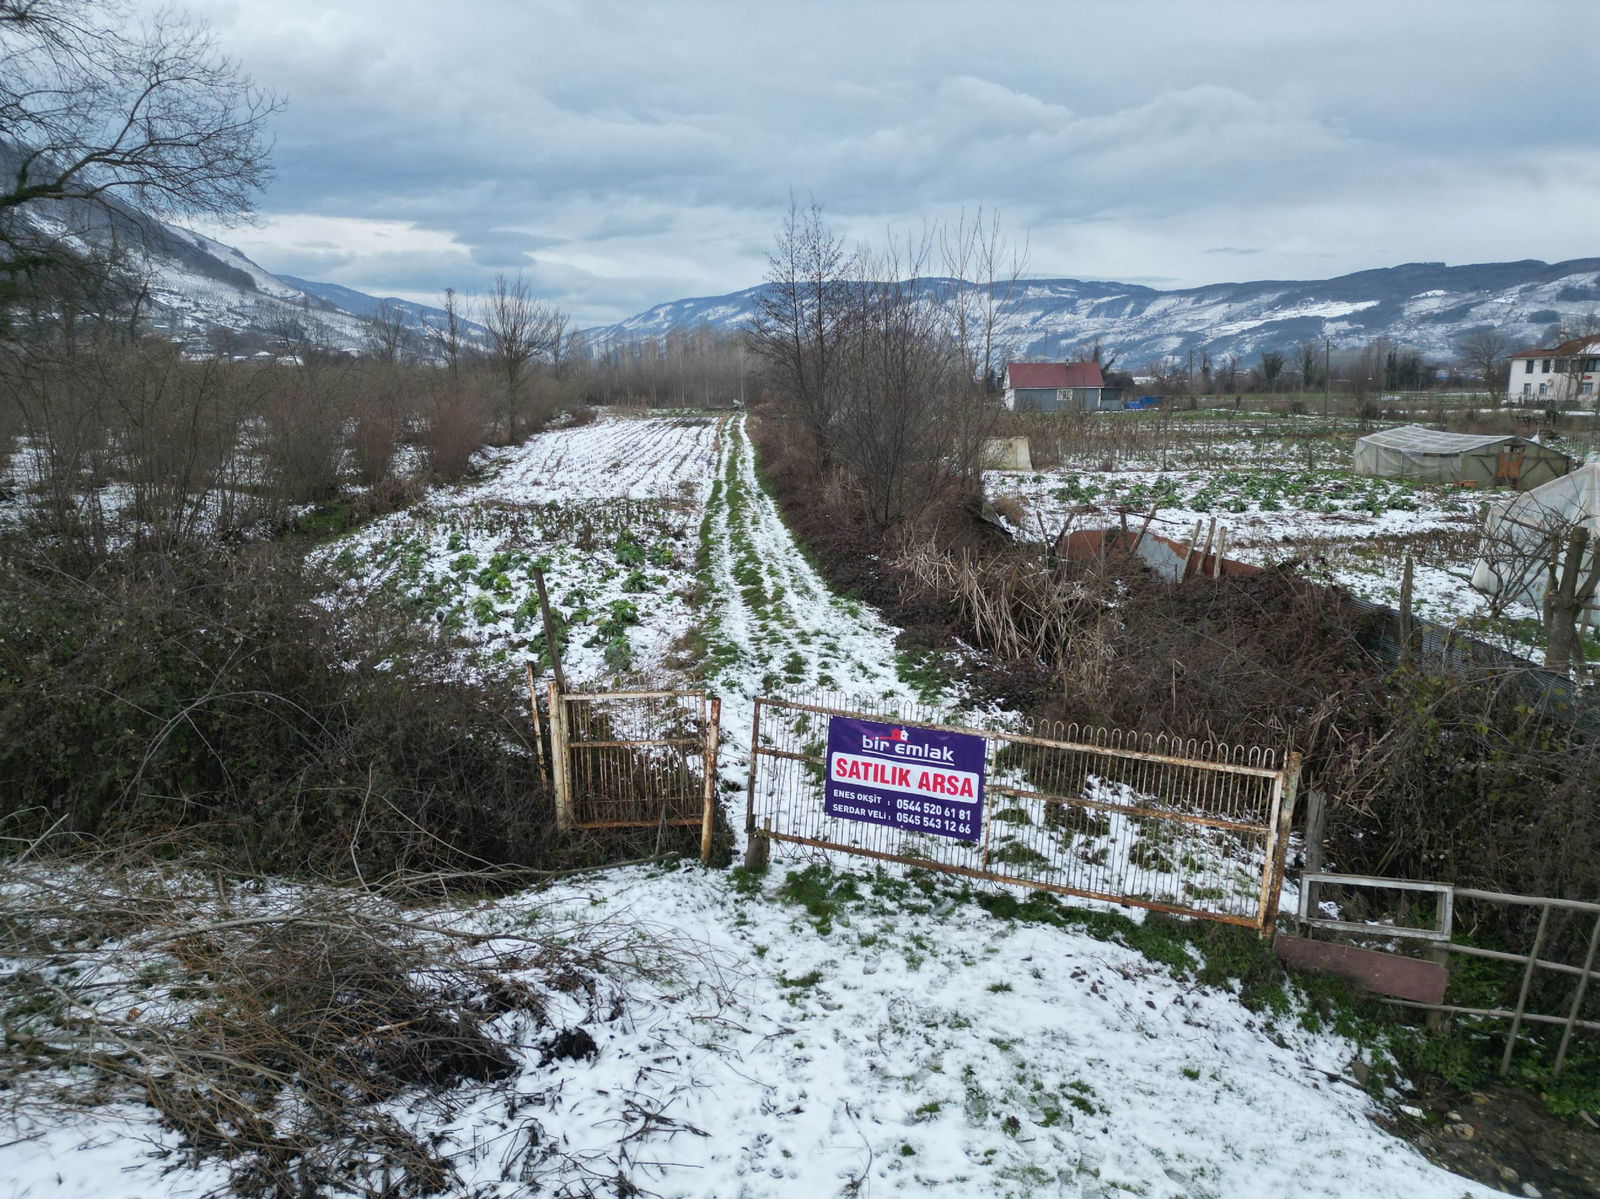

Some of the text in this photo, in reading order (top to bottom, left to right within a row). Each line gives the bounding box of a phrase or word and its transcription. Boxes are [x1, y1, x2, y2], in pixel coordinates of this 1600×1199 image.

[862, 735, 955, 762] bir emlak
[835, 758, 974, 798] SATILIK ARSA
[833, 789, 855, 800] ENES
[897, 799, 921, 812] 0544
[923, 803, 942, 815] 520
[944, 806, 956, 818] 61
[959, 809, 971, 821] 81
[833, 804, 865, 816] SERDAR
[868, 809, 886, 820] VELİ
[896, 812, 921, 825] 0545
[923, 816, 941, 829] 543
[944, 820, 956, 832] 12
[959, 824, 971, 834] 66
